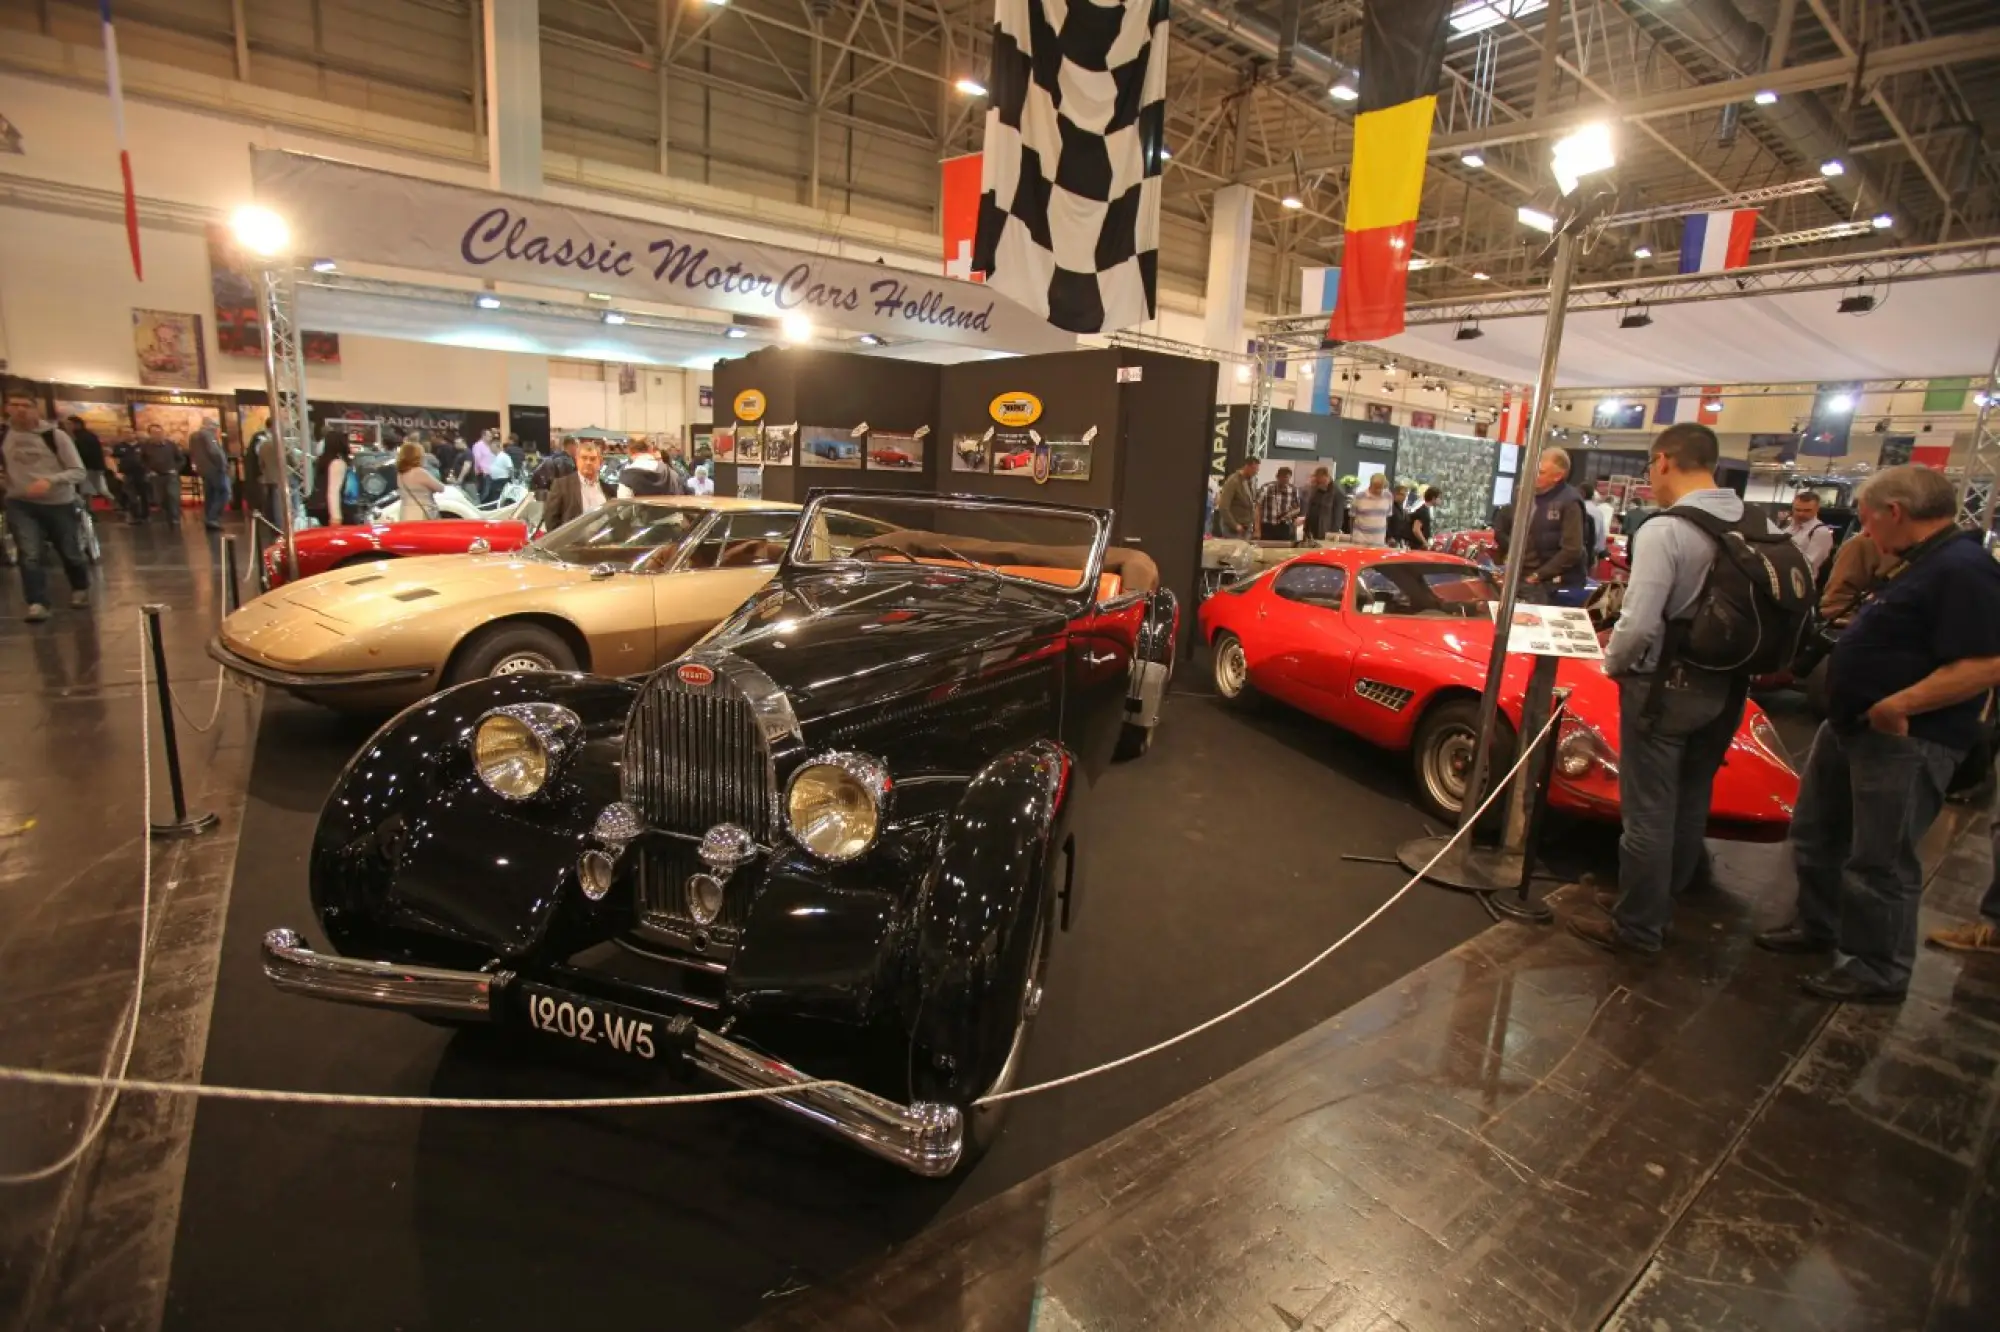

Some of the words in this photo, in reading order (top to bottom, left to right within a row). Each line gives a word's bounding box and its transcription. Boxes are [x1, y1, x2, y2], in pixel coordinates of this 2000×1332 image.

[461, 208, 634, 277] Classic
[870, 279, 994, 332] Holland
[374, 415, 460, 430] RAIDILLON
